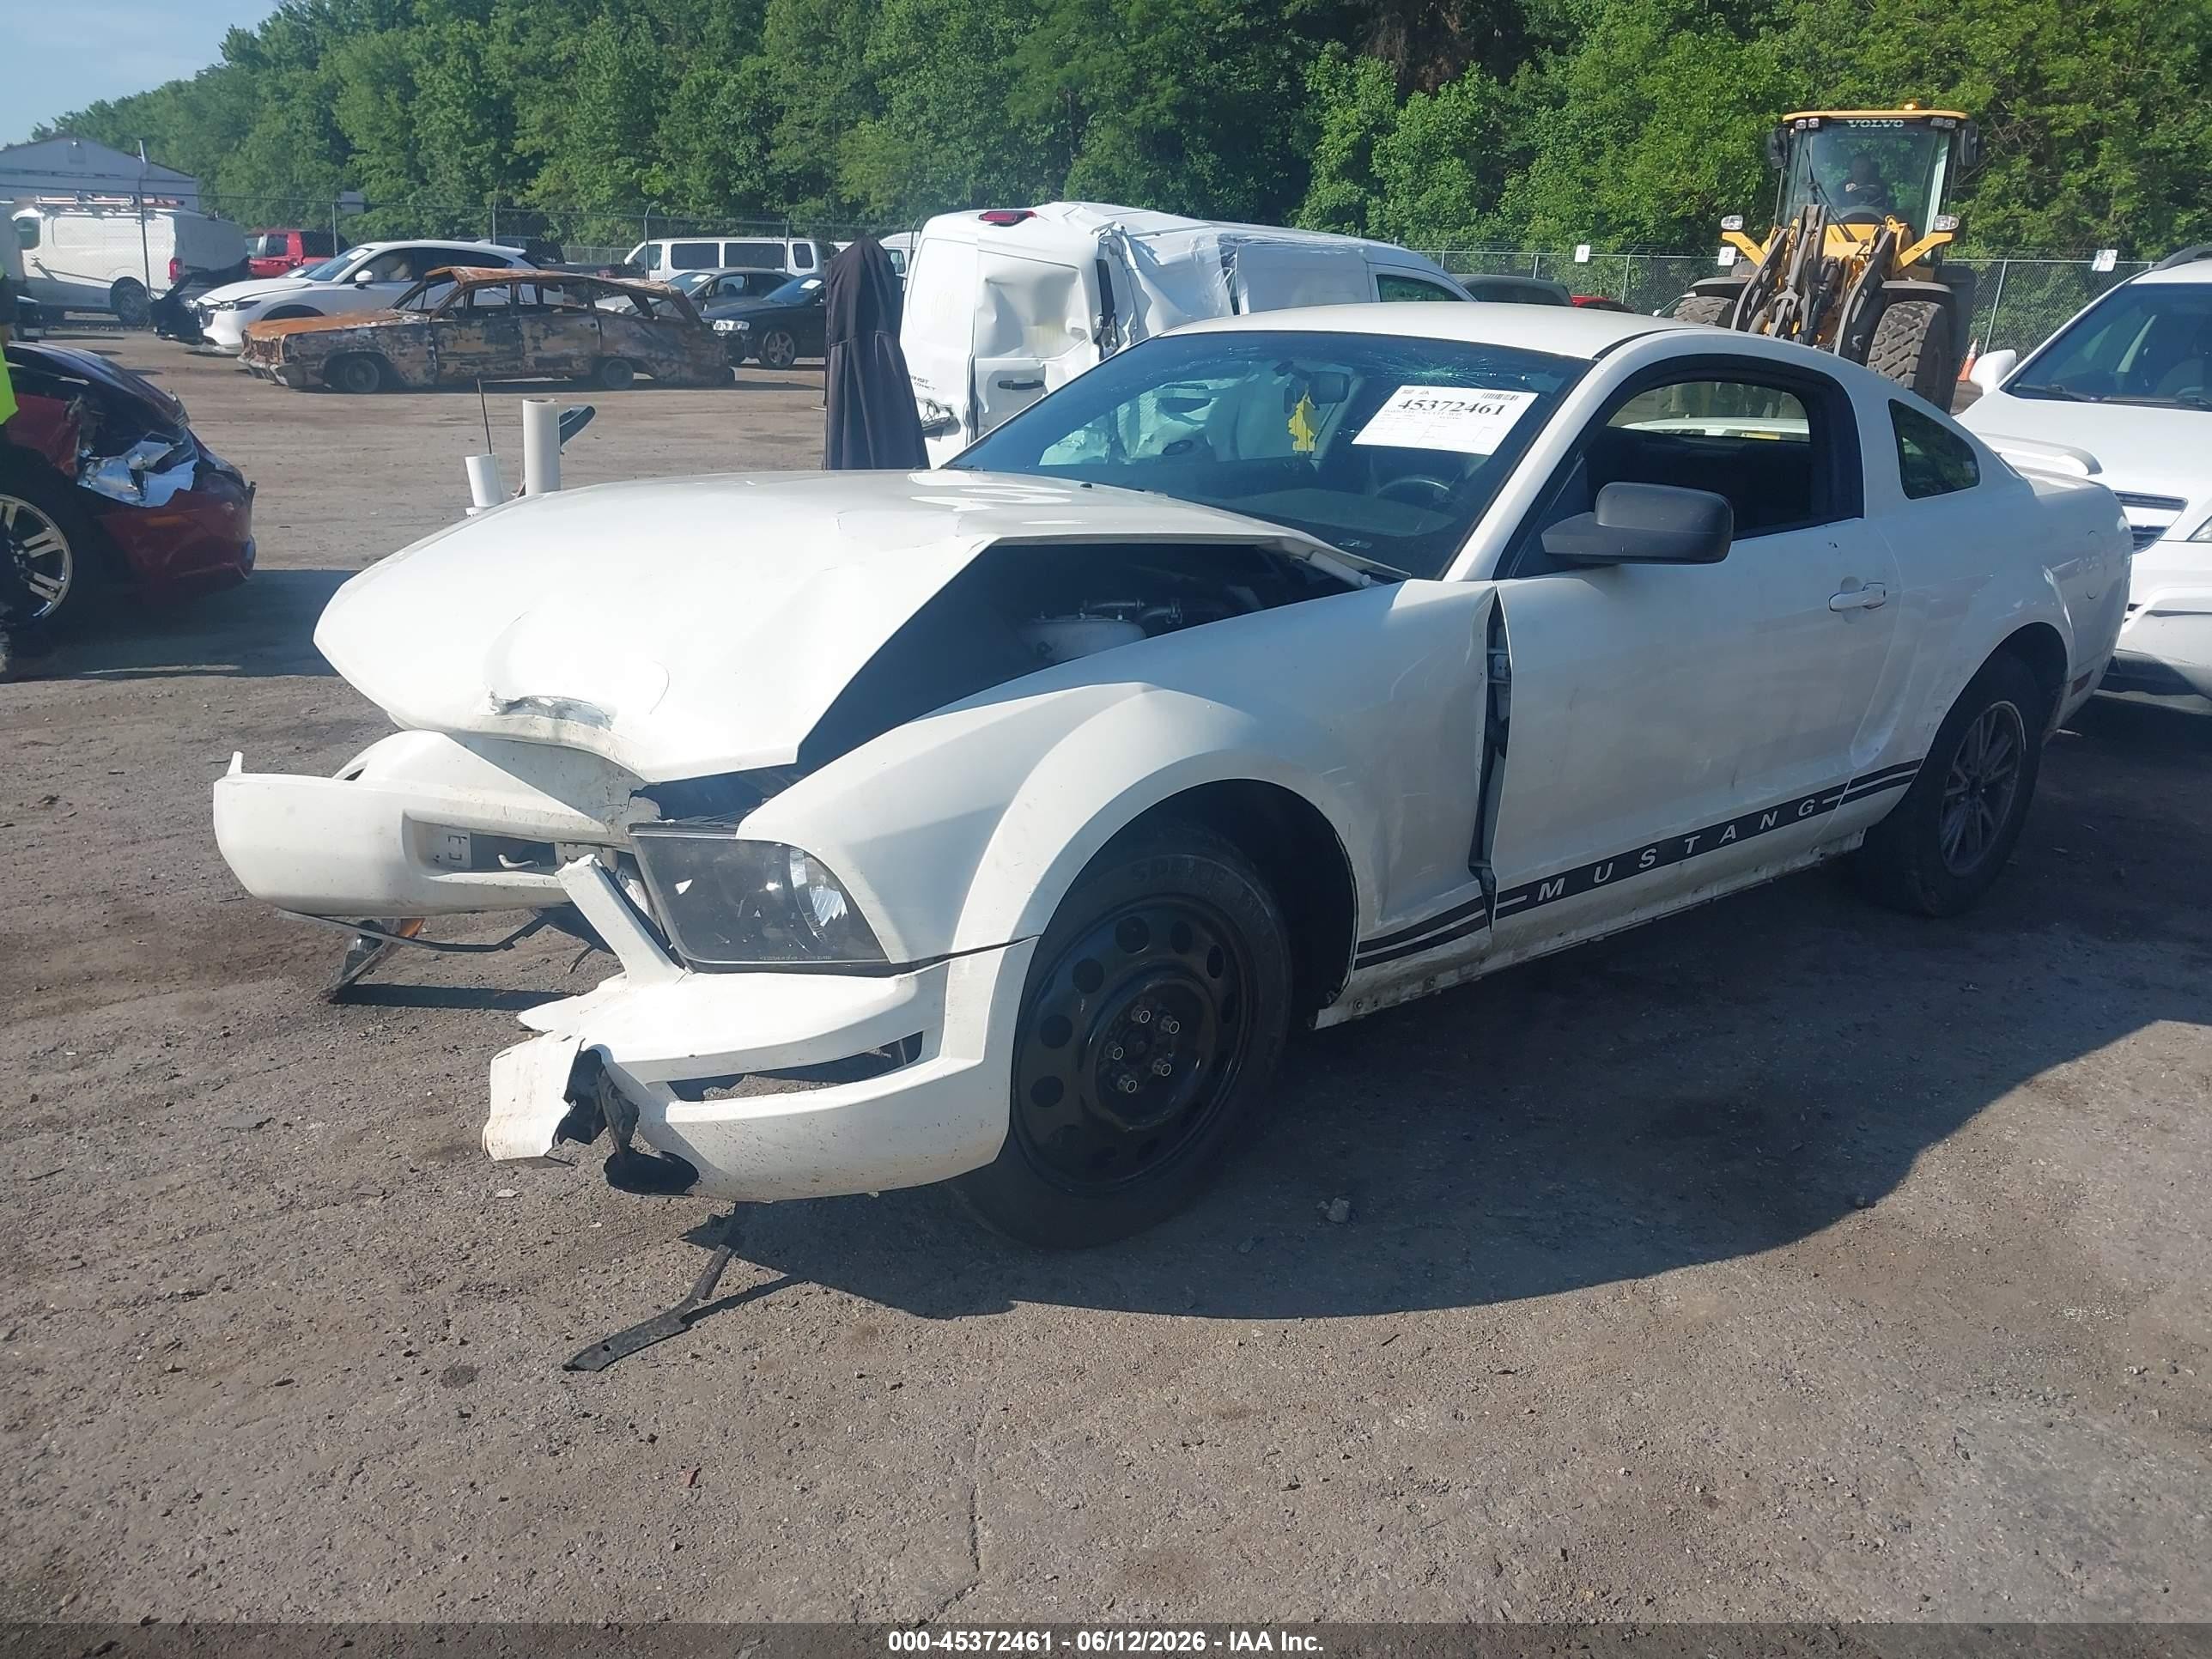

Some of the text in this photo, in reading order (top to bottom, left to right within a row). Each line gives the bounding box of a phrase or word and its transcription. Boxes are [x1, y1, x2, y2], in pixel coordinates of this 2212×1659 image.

[1845, 119, 1905, 128] VOLVO
[1397, 399, 1506, 416] 45372461
[1537, 799, 1815, 902] MUSTANG
